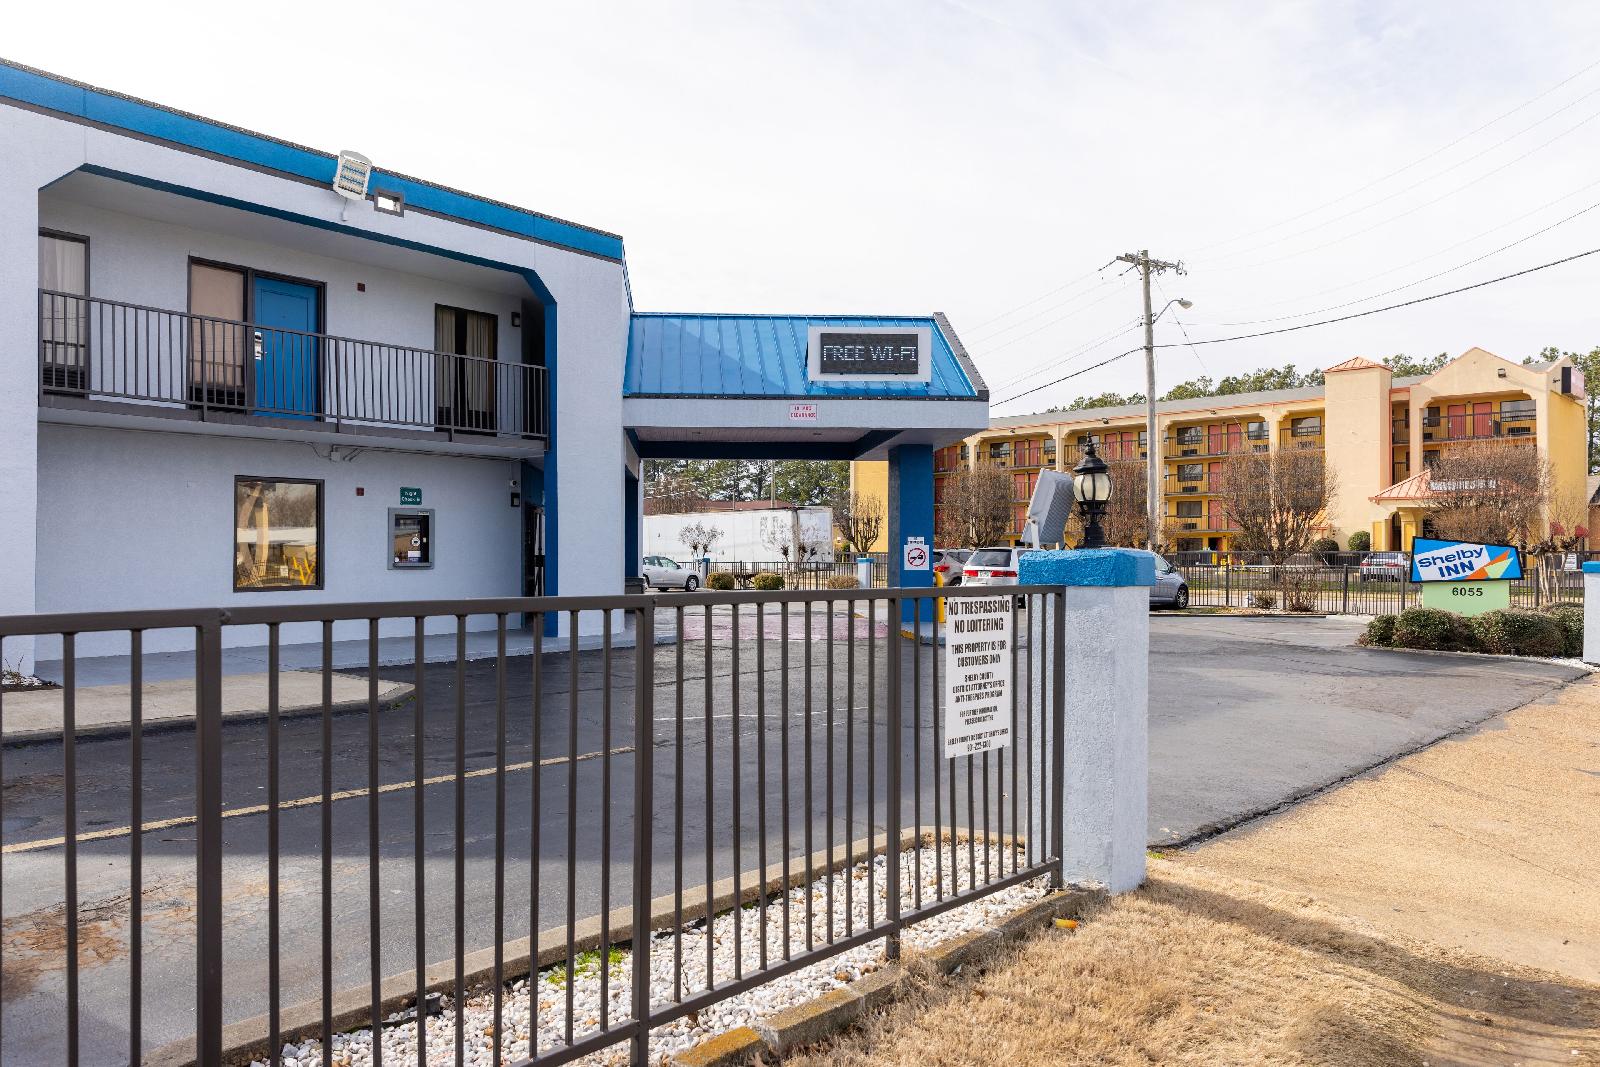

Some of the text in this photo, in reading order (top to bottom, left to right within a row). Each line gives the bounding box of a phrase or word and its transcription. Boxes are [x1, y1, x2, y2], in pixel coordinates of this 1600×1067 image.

[823, 345, 917, 361] FREE WI-FI
[1417, 547, 1484, 568] Shelby
[1438, 560, 1475, 578] INN
[1452, 587, 1484, 597] 6055
[948, 600, 1010, 615] NO TRESPASSING
[954, 617, 1004, 633] NO LOITERING
[951, 640, 1007, 655] THIS PROPERTY IS FOR
[957, 653, 1001, 667] CUSTOMERS ONLY
